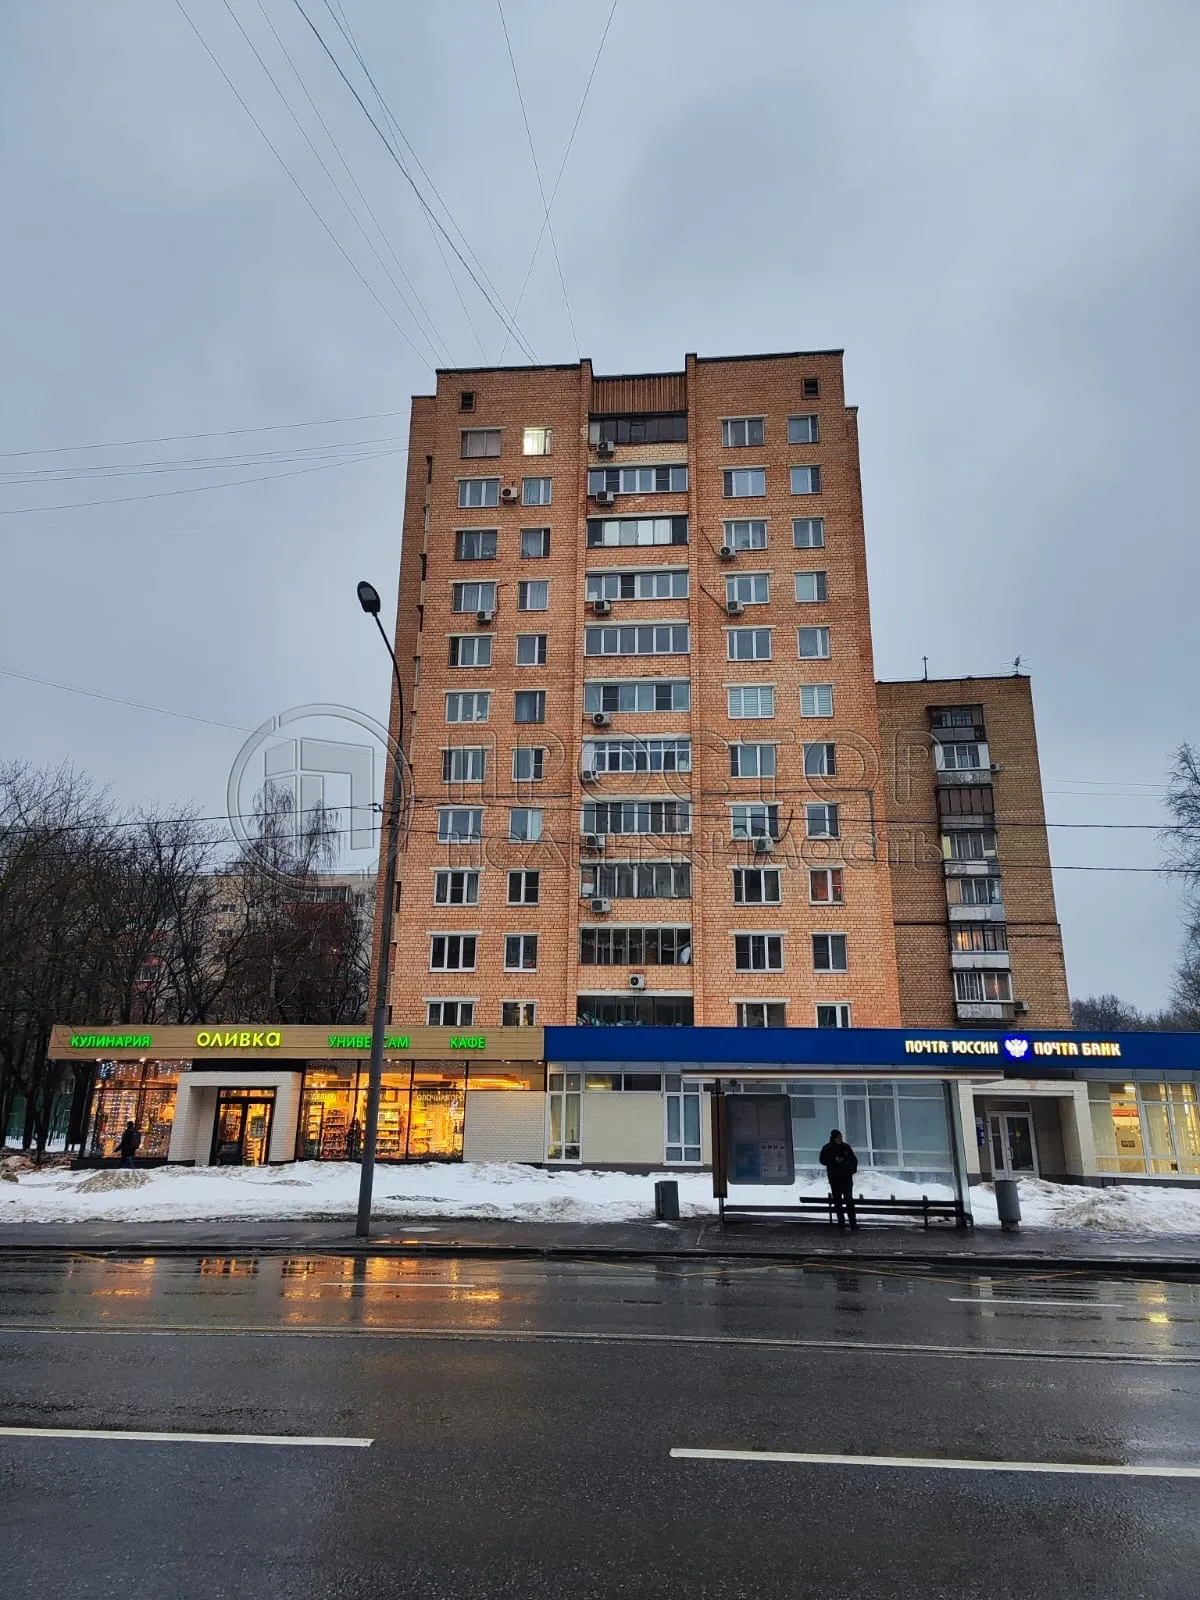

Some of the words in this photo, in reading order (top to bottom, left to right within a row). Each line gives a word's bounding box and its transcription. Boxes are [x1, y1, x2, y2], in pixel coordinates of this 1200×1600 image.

[70, 1035, 150, 1048] КУЛИНАРИЯ
[450, 1036, 486, 1049] КАФЕ
[905, 1040, 947, 1054] ПОЧТА
[951, 1041, 998, 1054] РОССИИ
[1034, 1042, 1078, 1056] ПОЧТА
[1082, 1043, 1121, 1056] БАНК
